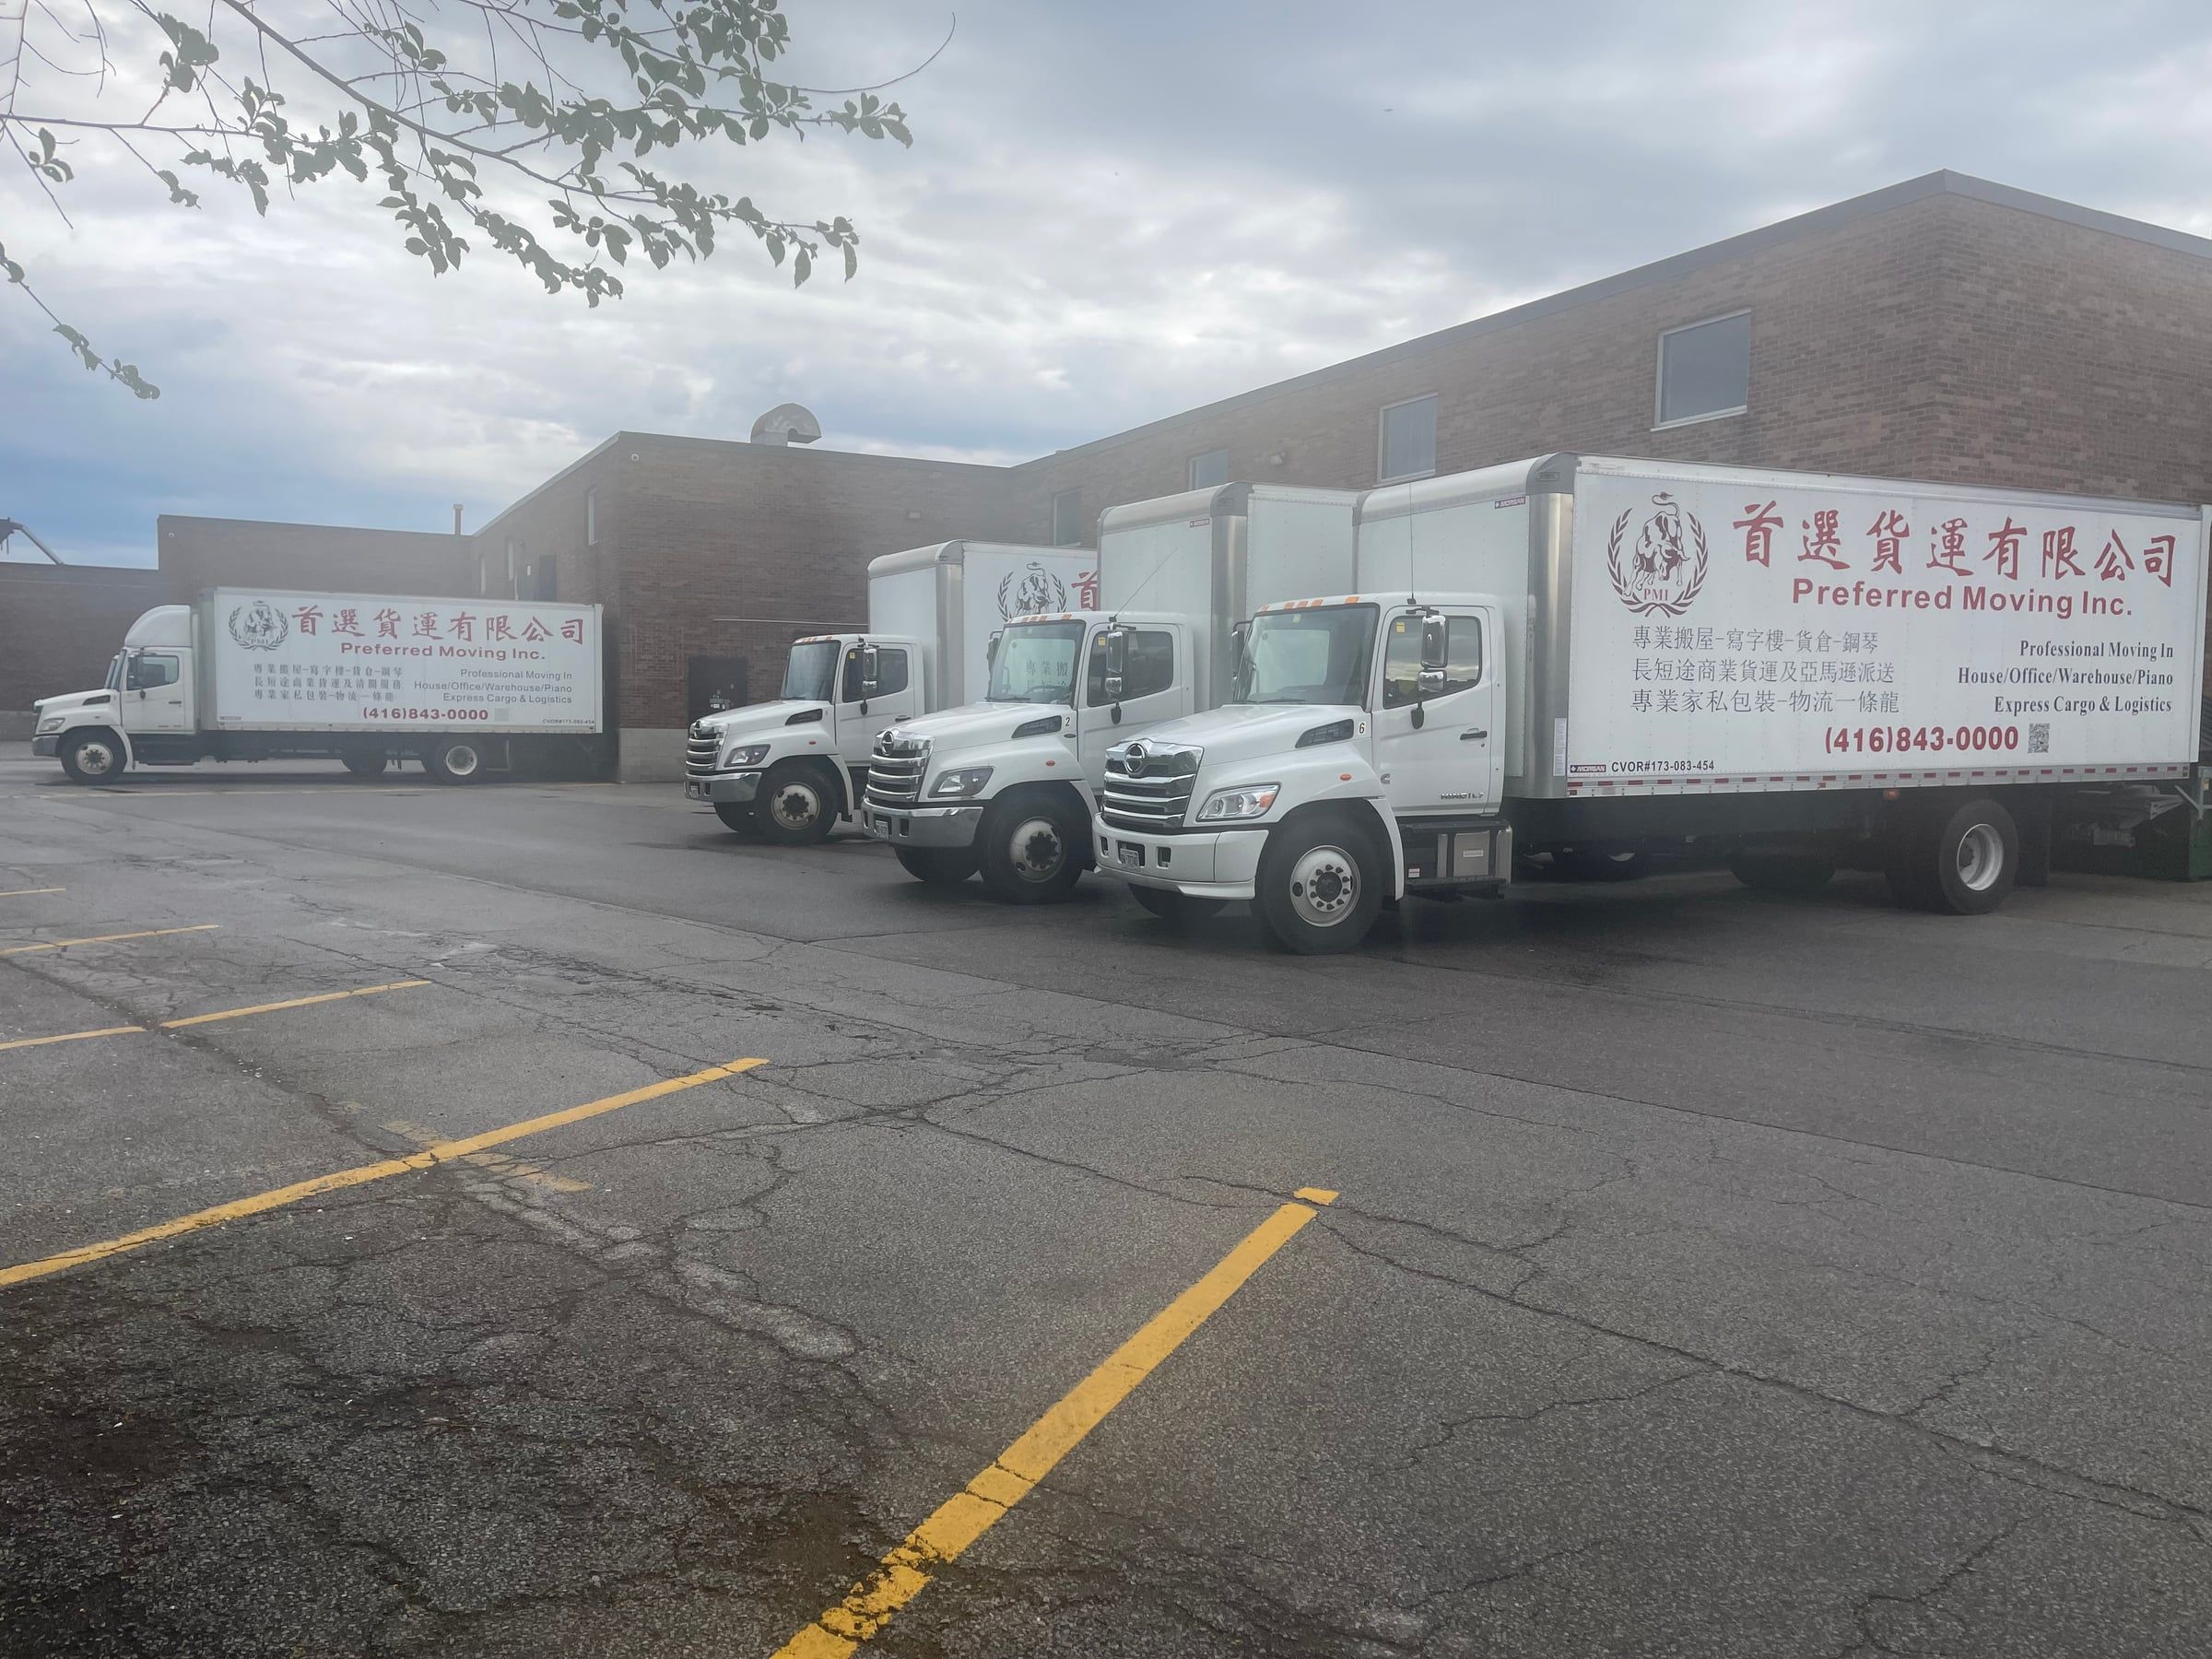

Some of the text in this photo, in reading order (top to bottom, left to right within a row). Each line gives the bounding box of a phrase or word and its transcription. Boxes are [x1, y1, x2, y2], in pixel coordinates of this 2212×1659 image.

[1733, 500, 2176, 588] 首選貨運有限公司
[1643, 588, 1668, 601] PMI
[1793, 578, 2133, 618] Preferred Moving Inc.
[291, 605, 583, 645] 首選貨運有限公司
[341, 642, 546, 661] Preferred Moving Inc.
[2020, 641, 2174, 662] Professional Moving In
[460, 668, 572, 681] Professional Moving In
[1632, 658, 1895, 683] 長短途商業貨運及亞馬遜派送
[1958, 667, 2173, 687] House/Office/Warehouse/Piano
[414, 680, 572, 694] House/Office/Warehouse/Piano
[443, 693, 572, 705] Express Cargo & Logistics
[1994, 696, 2172, 716] Express Cargo & Logistics
[363, 708, 488, 722] (416)843-0000
[1065, 716, 1070, 727] 2
[1359, 722, 1365, 735] 6
[1825, 726, 2018, 754] (416)843-0000
[1611, 759, 1715, 772] CVOR#173-083-454
